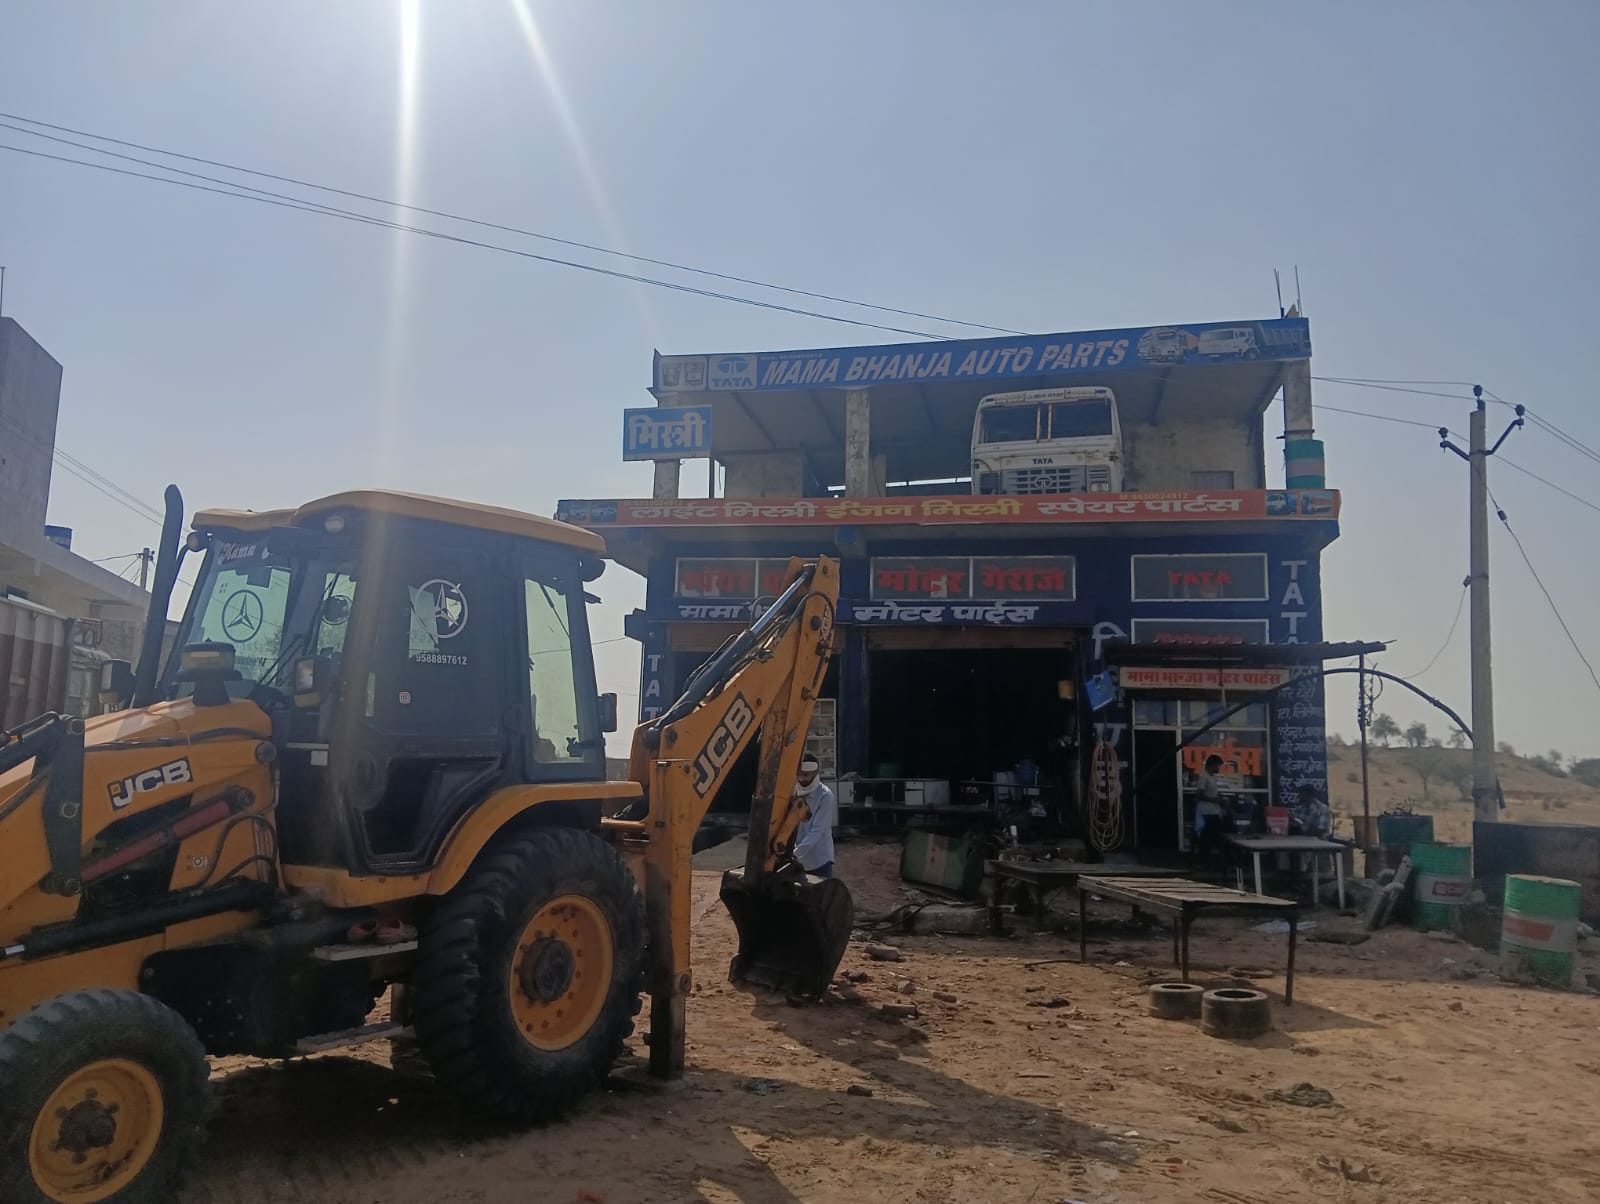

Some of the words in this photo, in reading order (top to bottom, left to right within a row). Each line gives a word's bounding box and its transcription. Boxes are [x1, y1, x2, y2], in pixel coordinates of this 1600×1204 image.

[760, 358, 840, 385] MAMA
[844, 351, 952, 381] BHANJA
[955, 345, 1033, 376] AUTO
[1036, 339, 1129, 370] PARTS
[711, 377, 753, 387] TATA
[1032, 457, 1054, 465] TATA
[1168, 571, 1231, 586] TATA
[852, 600, 945, 622] मोटर
[694, 697, 751, 794] JCB
[112, 758, 192, 808] JCB
